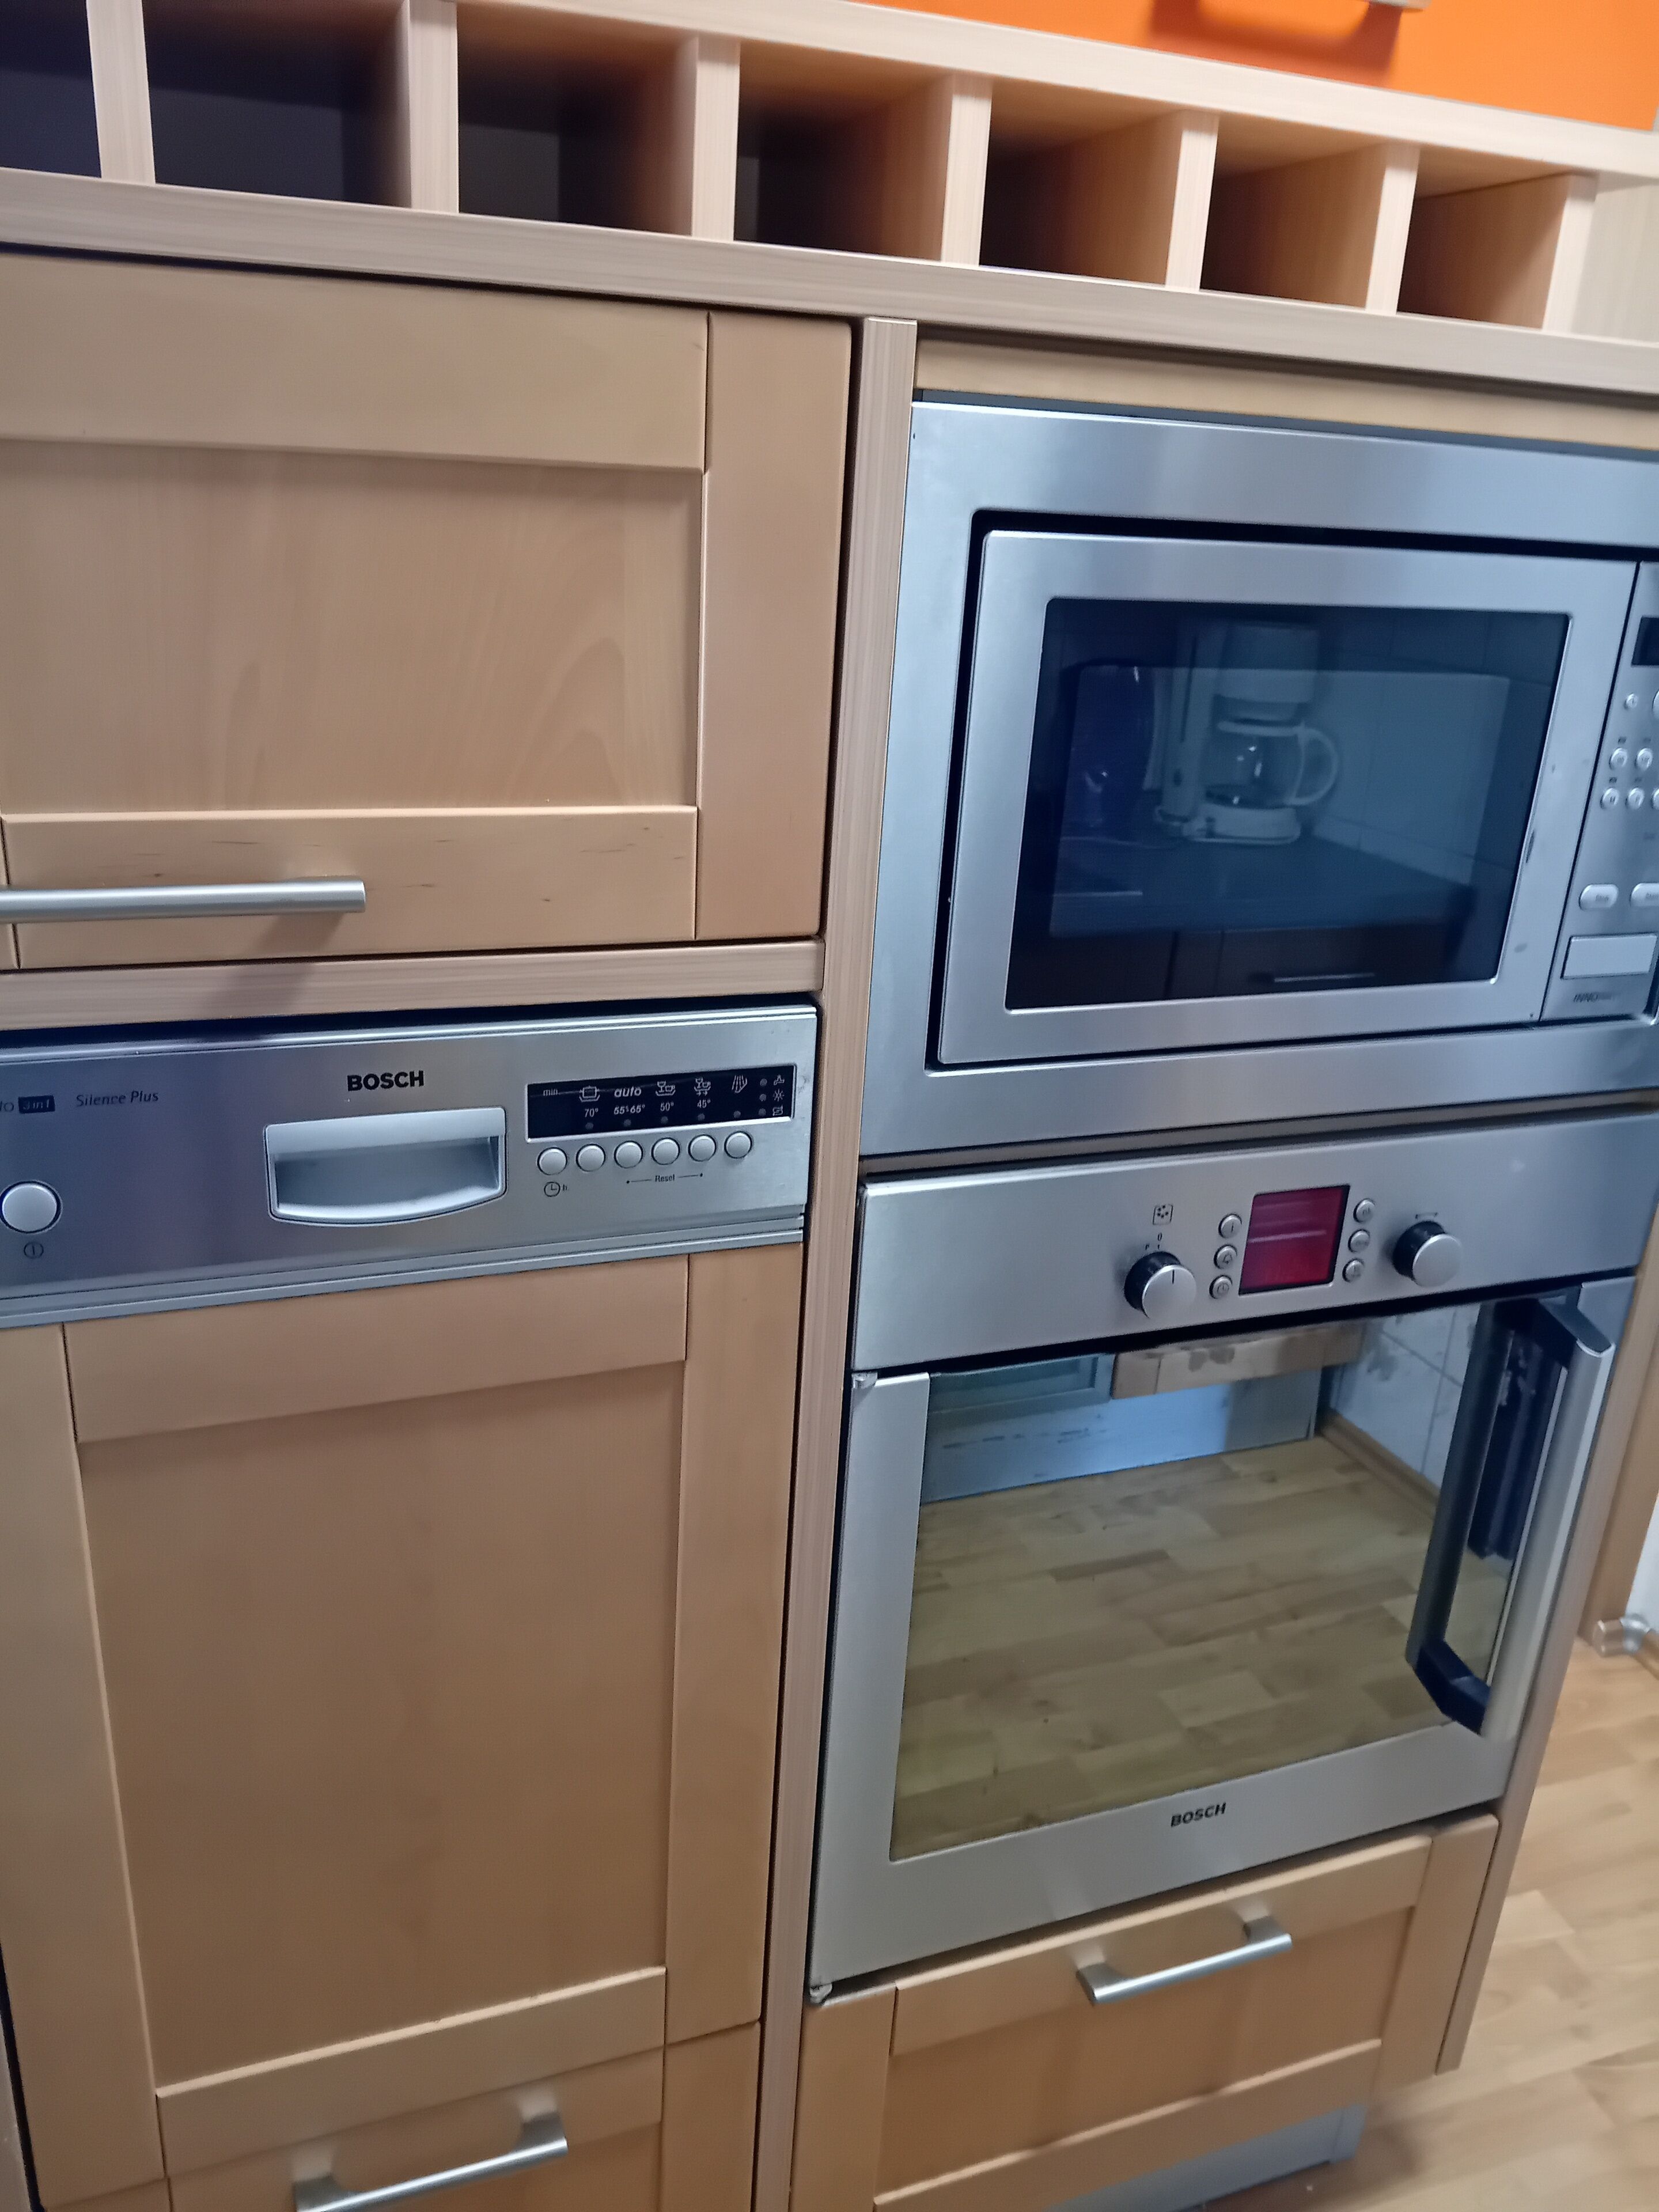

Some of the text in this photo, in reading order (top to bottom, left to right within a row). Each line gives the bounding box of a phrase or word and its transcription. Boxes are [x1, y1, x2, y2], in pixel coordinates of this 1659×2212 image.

[347, 1070, 424, 1091] BOSCH
[76, 1090, 159, 1107] Silence Plus
[614, 1086, 642, 1097] auto
[1171, 1802, 1226, 1827] BOSCH
